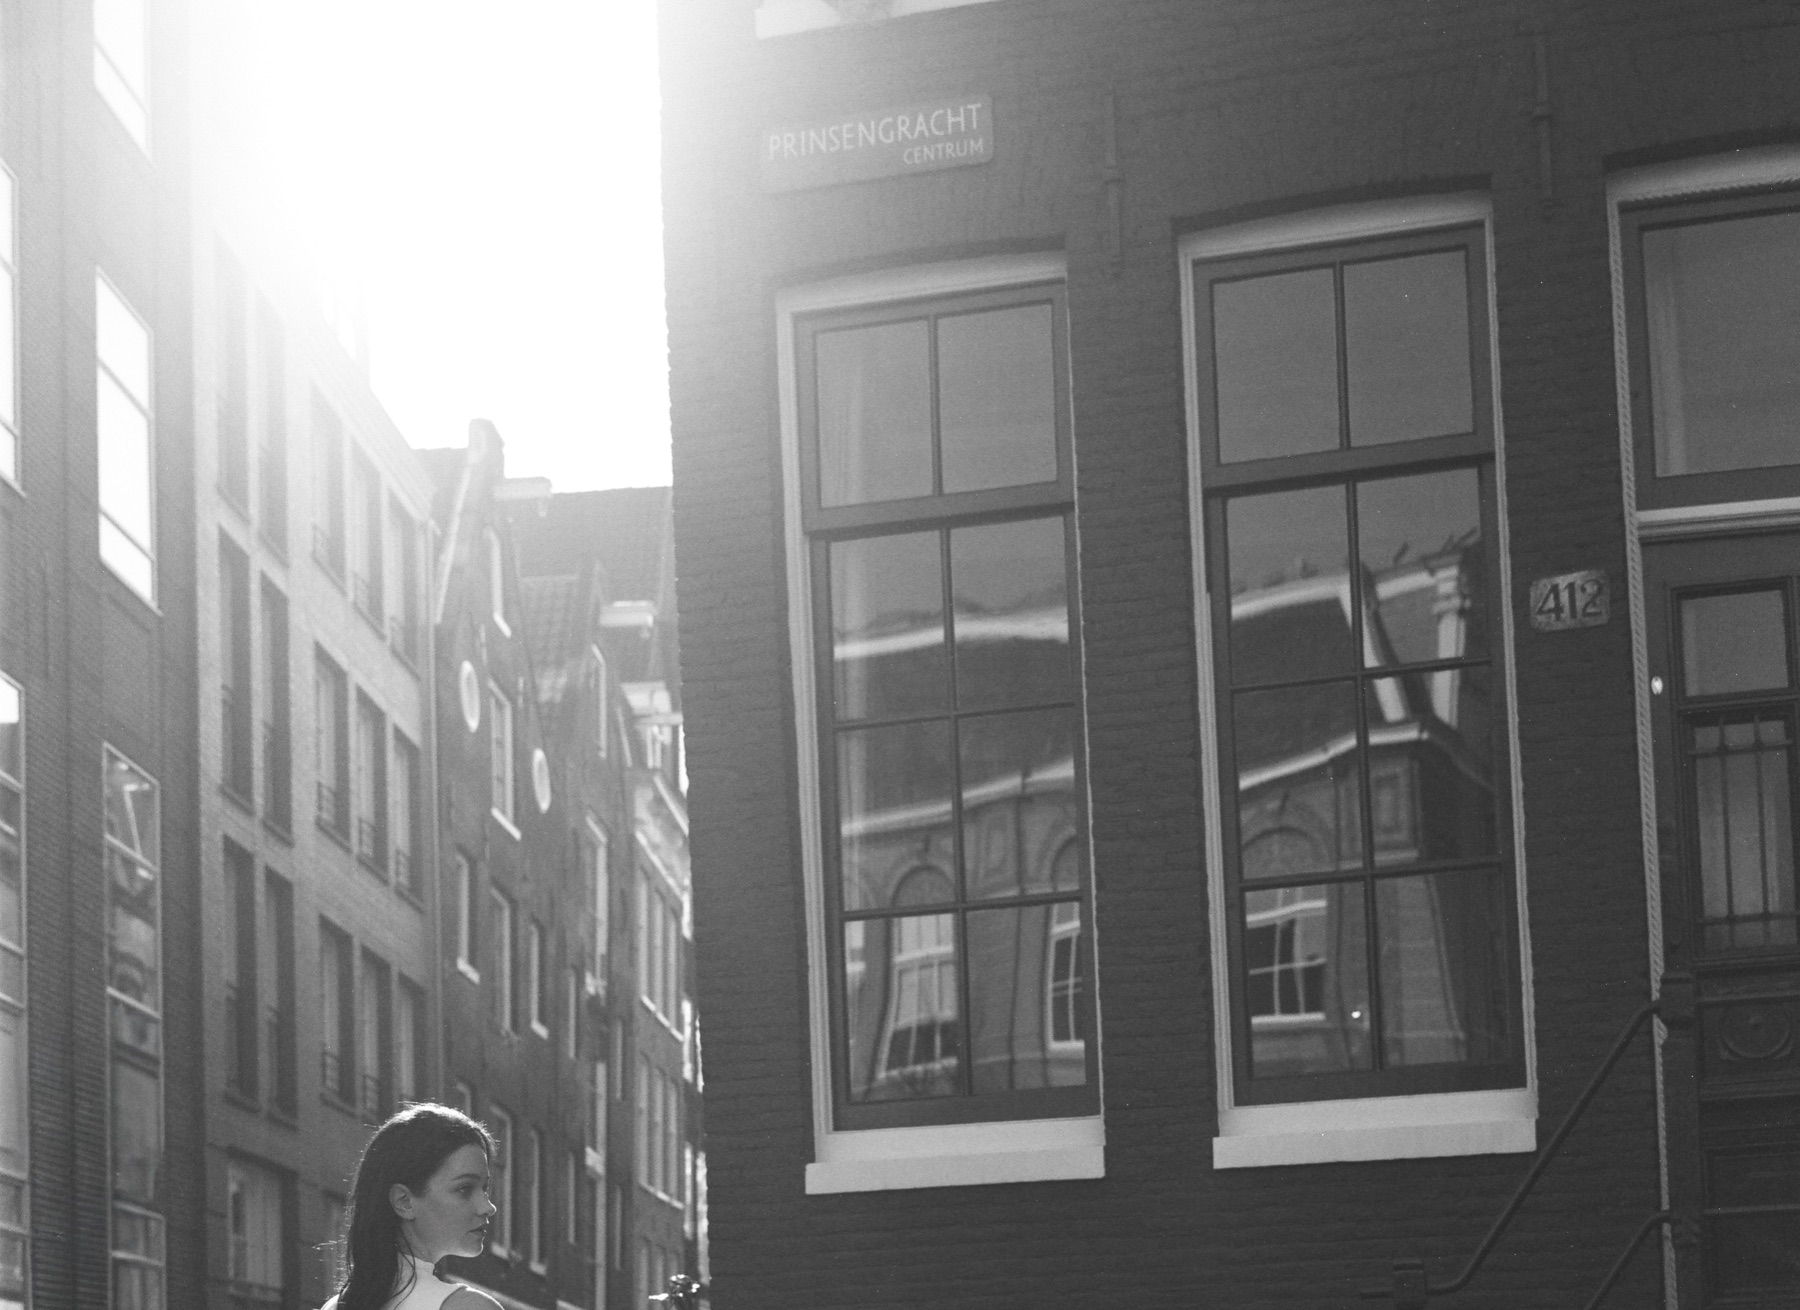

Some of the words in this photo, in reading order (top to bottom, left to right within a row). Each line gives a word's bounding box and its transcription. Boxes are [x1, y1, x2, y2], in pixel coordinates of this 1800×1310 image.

[767, 102, 982, 161] PRINSENGRACHT
[903, 137, 984, 164] CENTRUM
[1536, 578, 1603, 621] 412
